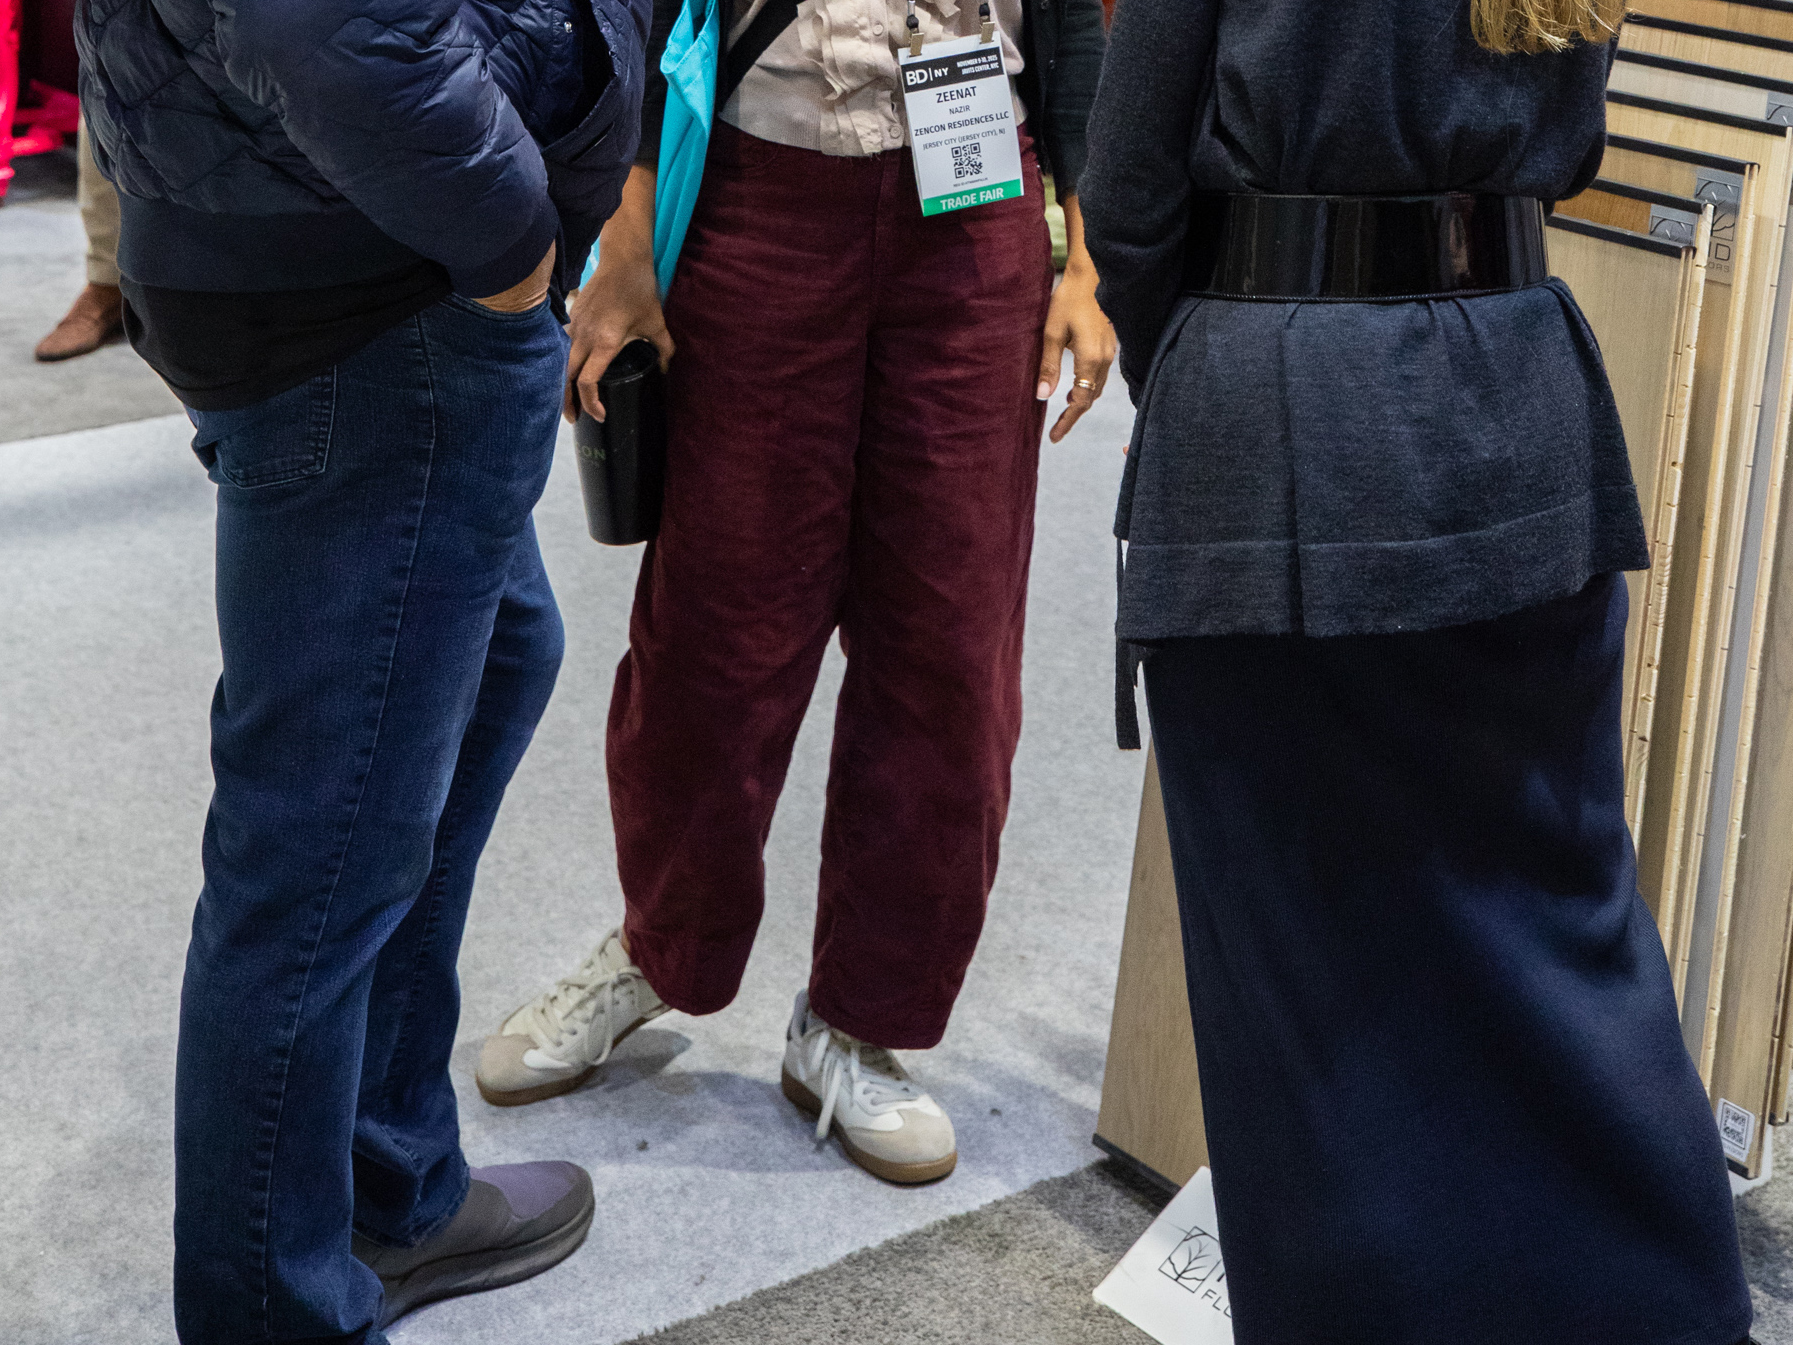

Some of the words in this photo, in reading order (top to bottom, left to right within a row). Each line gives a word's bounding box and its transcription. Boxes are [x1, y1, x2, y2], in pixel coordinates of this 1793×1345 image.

[935, 85, 977, 104] ZEENAT
[948, 104, 971, 115] NAZIR
[913, 123, 946, 137] ZENCON
[947, 113, 995, 130] RESIDENCES
[995, 110, 1010, 121] LLC
[922, 140, 943, 151] JERSEY
[944, 137, 958, 146] CITY
[940, 192, 977, 211] TRADE
[979, 187, 1004, 202] FAIR
